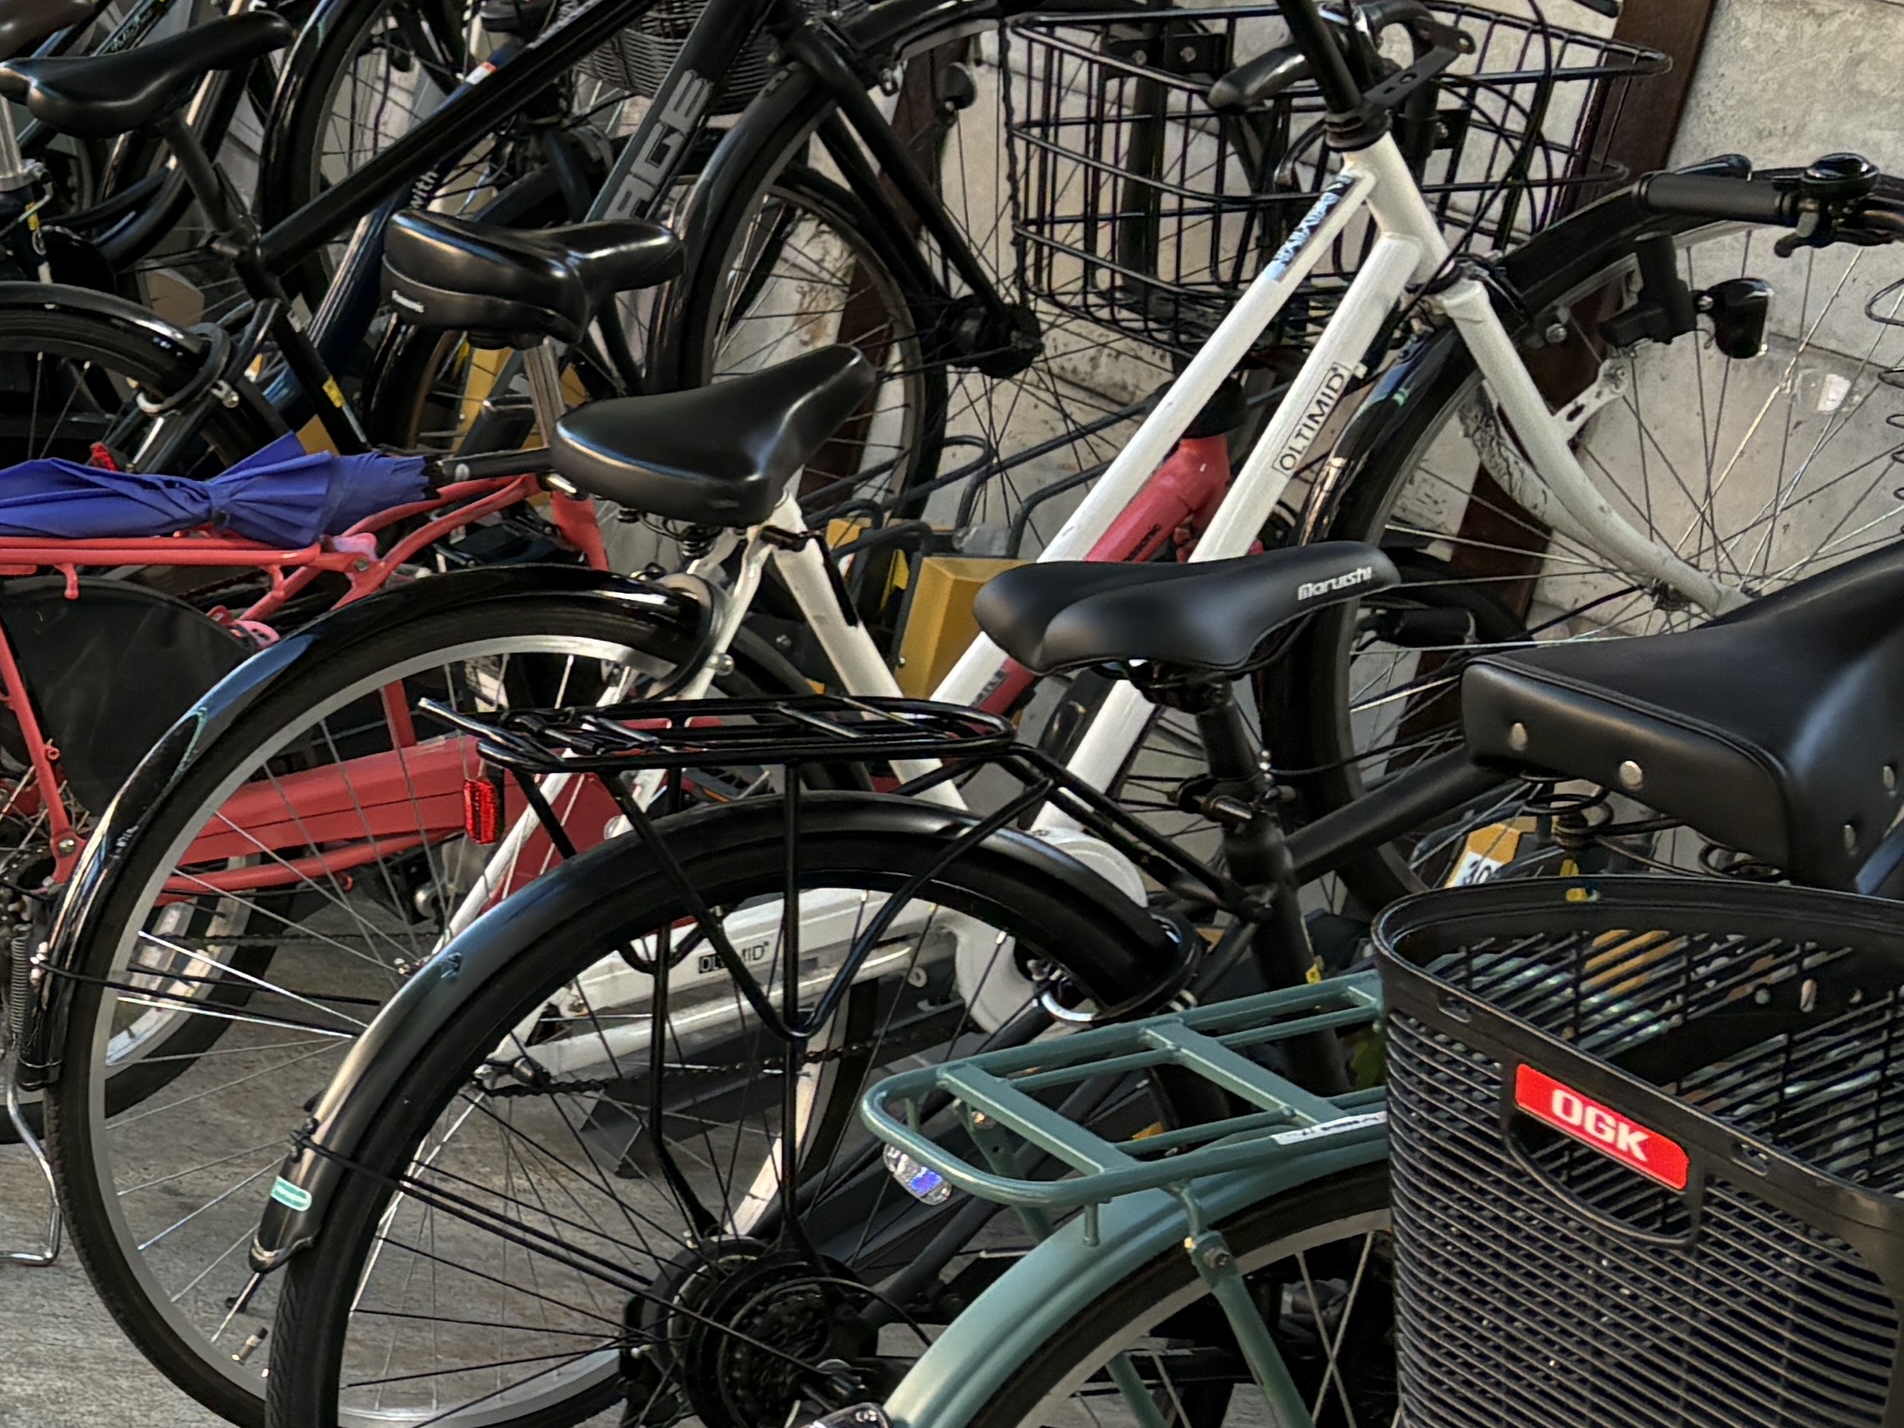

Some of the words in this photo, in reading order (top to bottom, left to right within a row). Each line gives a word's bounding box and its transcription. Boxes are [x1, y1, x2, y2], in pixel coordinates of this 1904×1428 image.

[1278, 370, 1346, 473] OLTIMID
[1297, 566, 1373, 601] Maruishi
[1552, 1088, 1651, 1163] OGK
